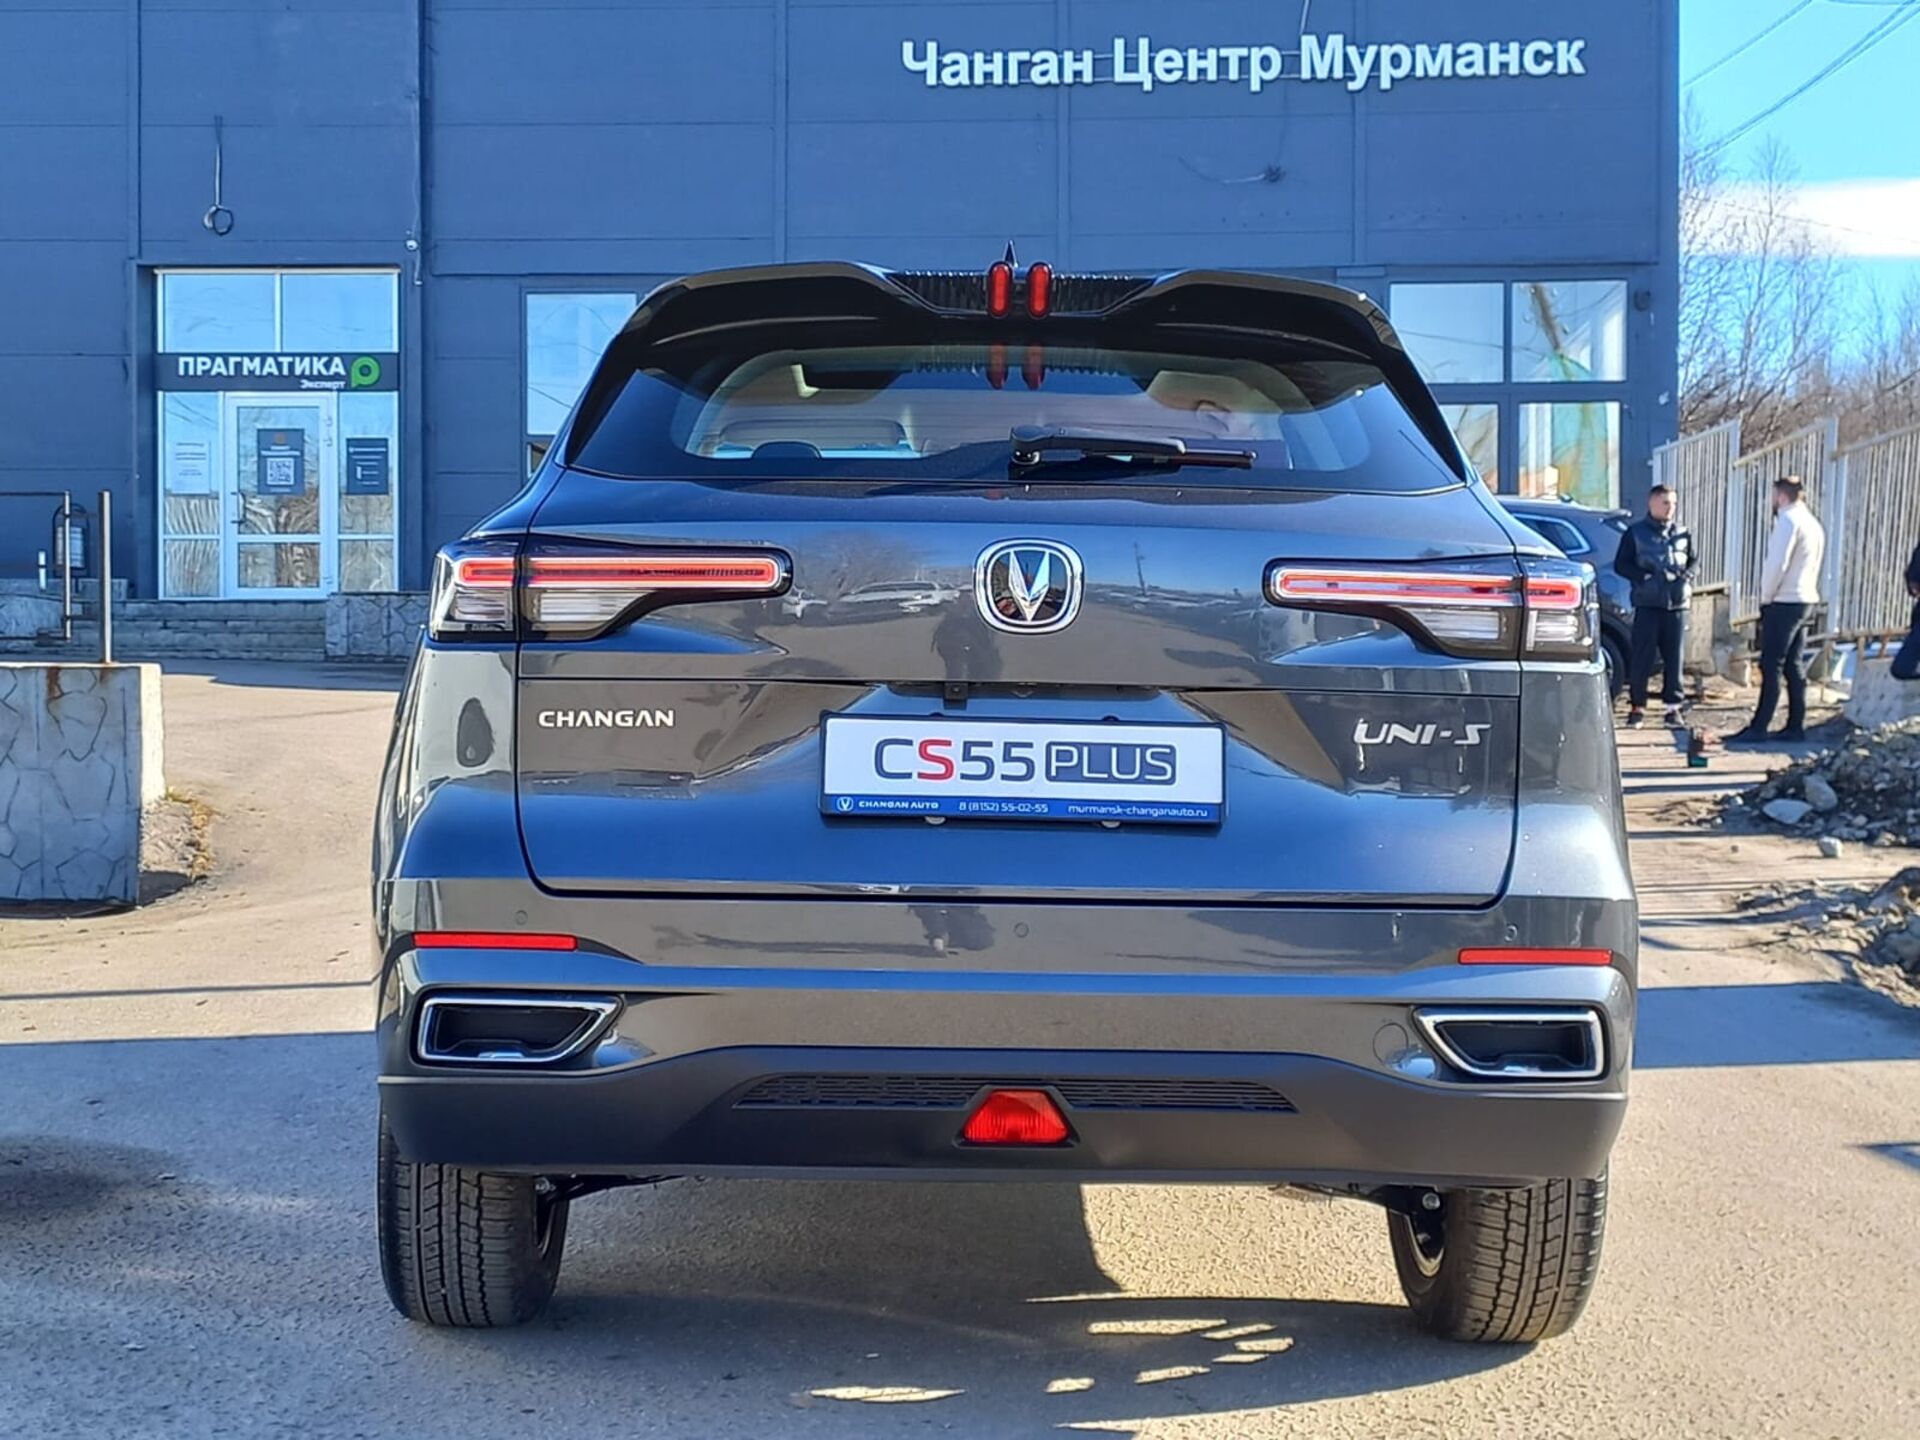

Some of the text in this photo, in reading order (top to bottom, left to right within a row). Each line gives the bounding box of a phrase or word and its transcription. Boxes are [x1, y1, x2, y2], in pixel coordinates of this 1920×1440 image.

[902, 33, 1586, 92] Чанган Центр Мурманск
[178, 356, 346, 376] ПРАГМАТИКА
[300, 379, 346, 390] Эксперт
[538, 709, 675, 728] CHANGAN
[1353, 722, 1492, 745] UNI-S
[858, 800, 1208, 818] CHANGAN AUTO 8 (8152) 55-02-55 murmansk-changanauto.ru
